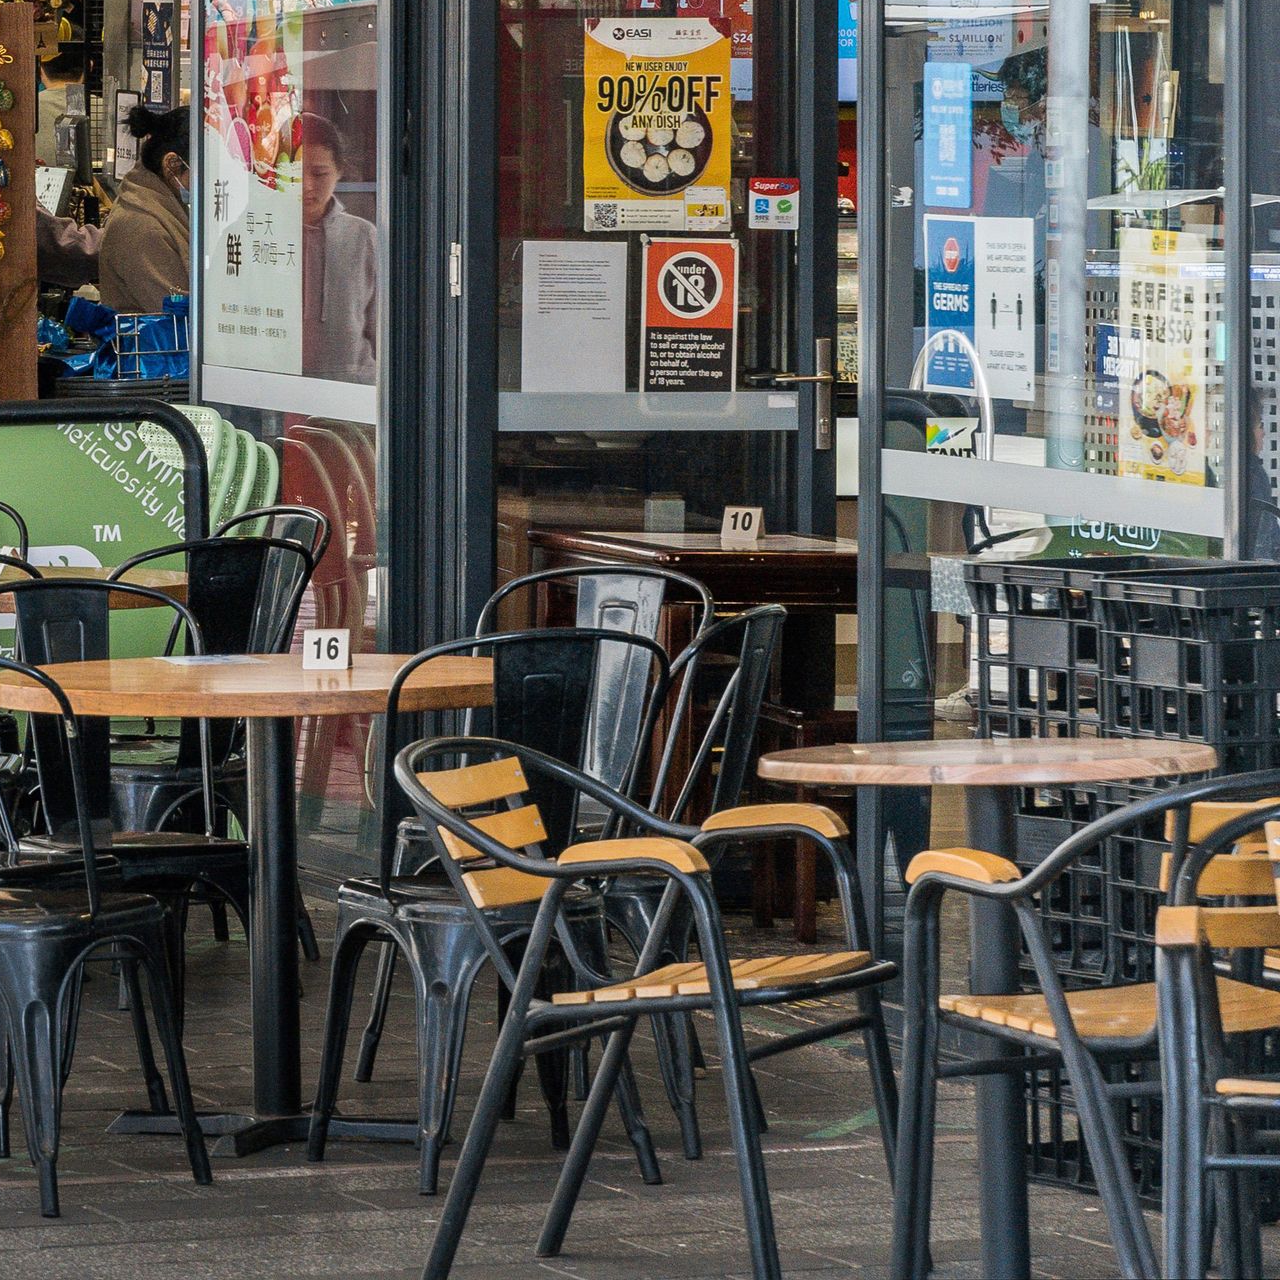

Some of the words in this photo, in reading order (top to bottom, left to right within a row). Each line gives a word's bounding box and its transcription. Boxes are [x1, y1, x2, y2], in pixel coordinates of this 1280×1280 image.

[626, 28, 652, 38] EASI
[625, 62, 642, 71] NEW
[644, 62, 663, 71] USER
[665, 62, 688, 72] ENJOY
[597, 74, 661, 113] 90%
[667, 75, 722, 113] OFF
[631, 115, 653, 128] ANY
[656, 115, 681, 128] DISH
[246, 211, 273, 235] 每一天
[672, 275, 705, 306] 18
[933, 282, 944, 290] THE
[944, 283, 962, 291] SPREAD
[933, 293, 969, 312] GERMS
[664, 333, 687, 342] against
[679, 343, 700, 351] supply
[701, 342, 725, 350] alcohol
[650, 351, 659, 359] to,
[665, 379, 685, 387] years.
[731, 512, 752, 531] 10
[93, 524, 122, 542] TM
[313, 637, 339, 660] 16
